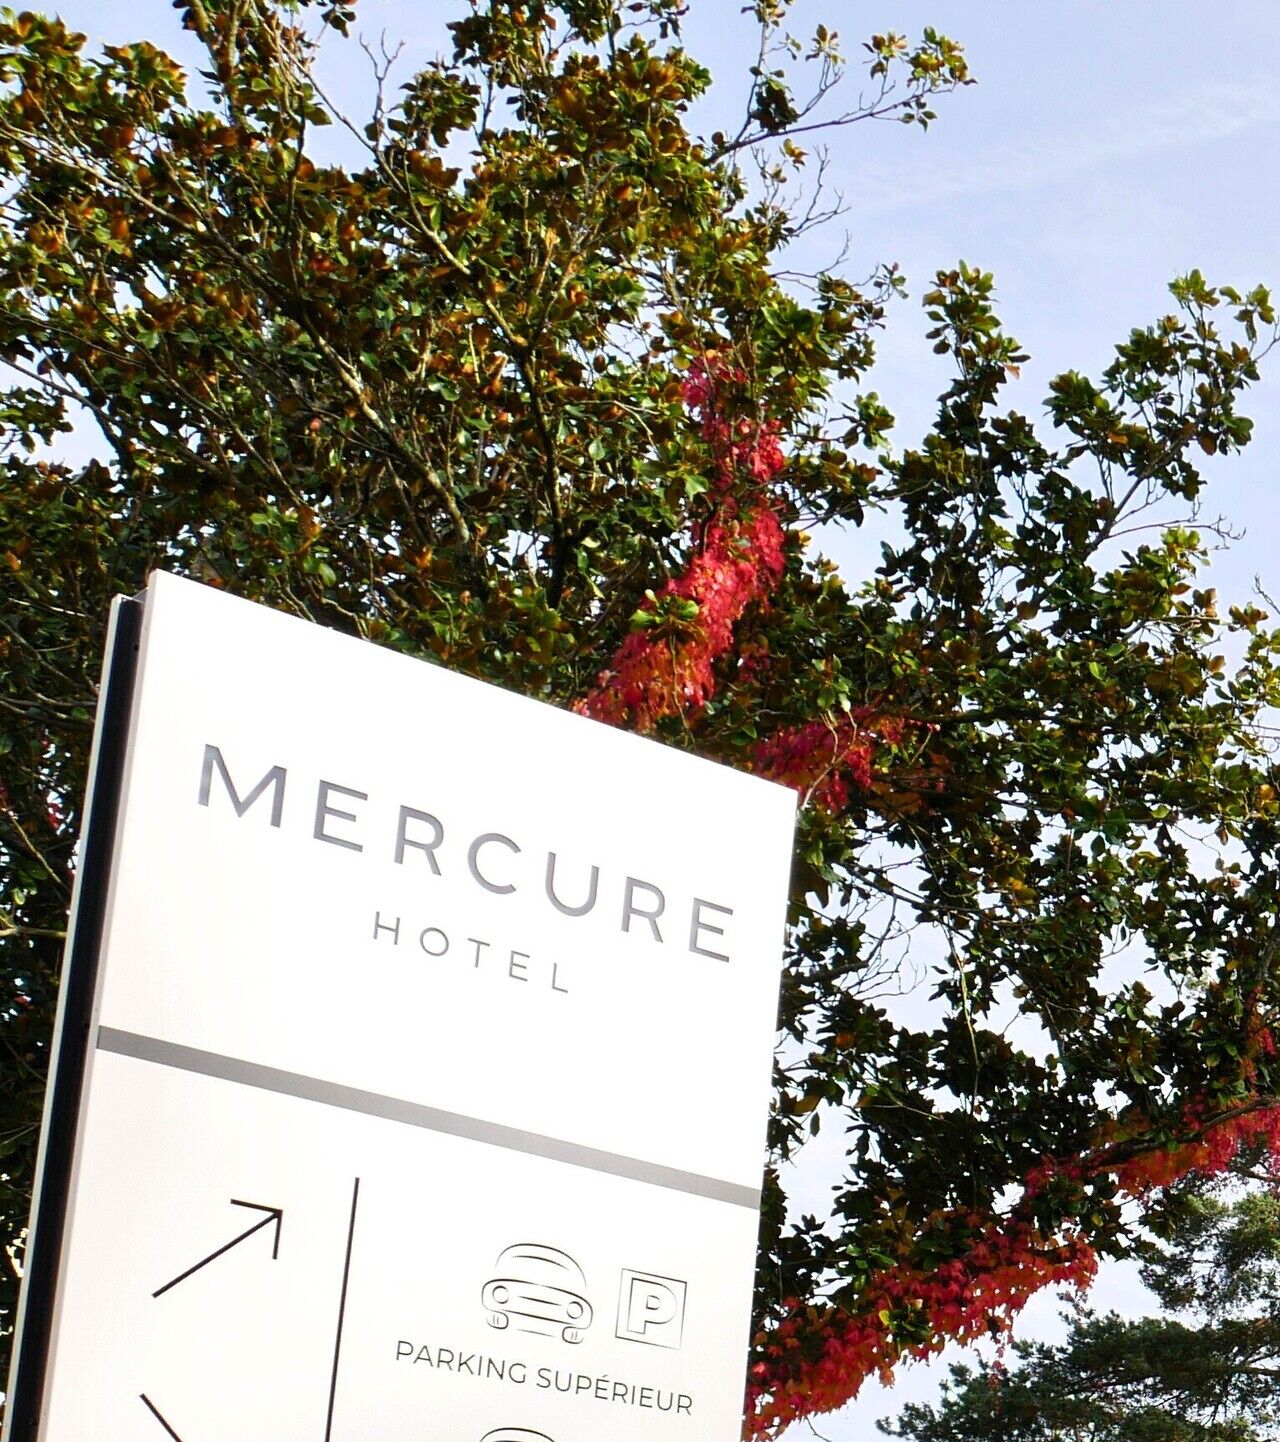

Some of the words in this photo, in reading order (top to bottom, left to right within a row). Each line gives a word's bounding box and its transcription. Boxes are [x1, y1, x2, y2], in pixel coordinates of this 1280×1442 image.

[197, 743, 734, 963] MERCURE
[373, 910, 570, 995] HOTEL
[627, 1277, 678, 1334] P
[395, 1340, 527, 1383] PARKING
[536, 1367, 693, 1415] SUPÉRIEUR
